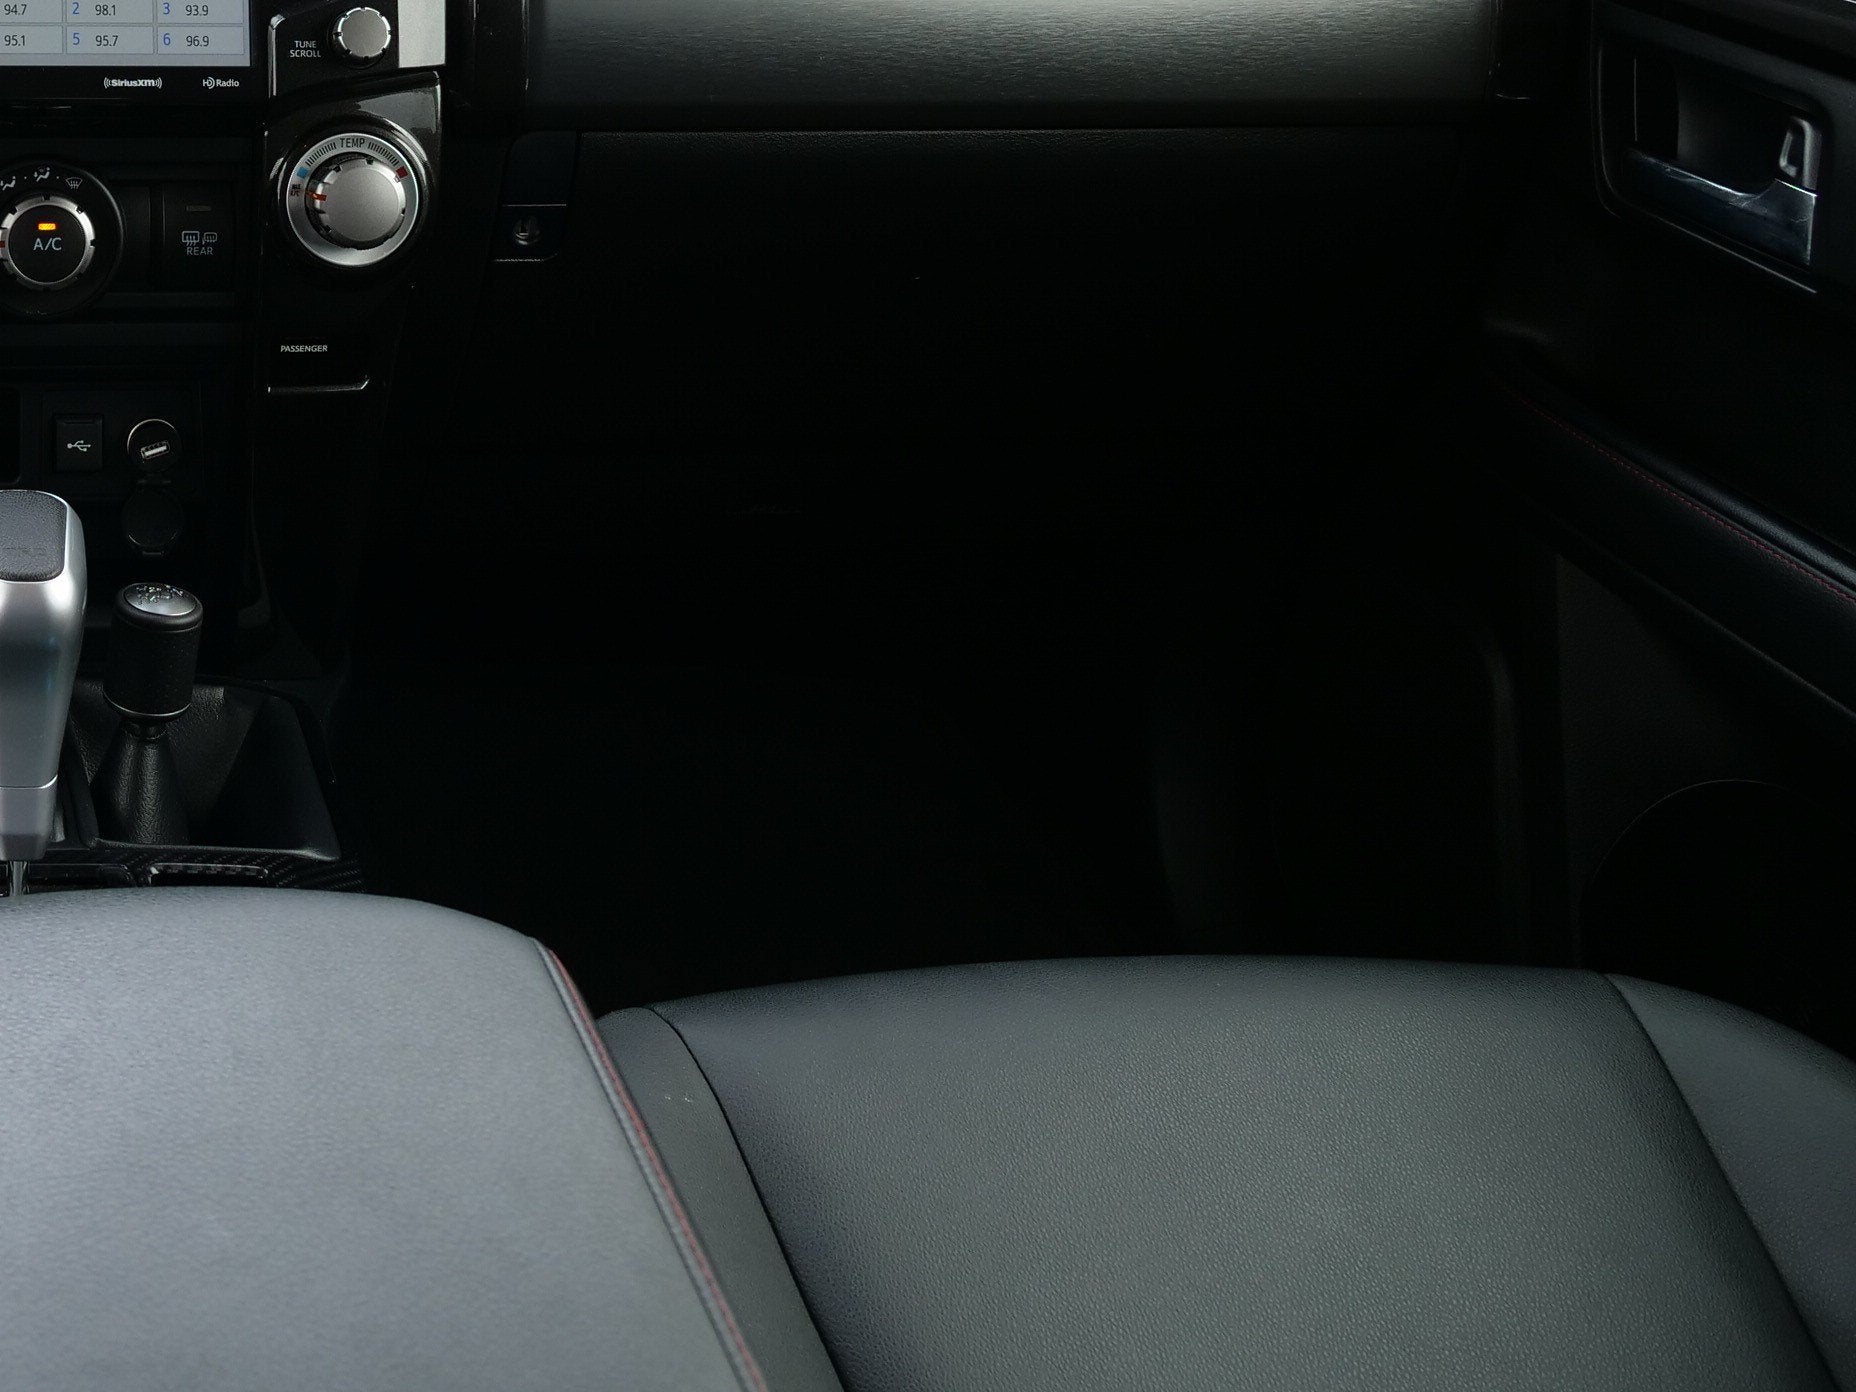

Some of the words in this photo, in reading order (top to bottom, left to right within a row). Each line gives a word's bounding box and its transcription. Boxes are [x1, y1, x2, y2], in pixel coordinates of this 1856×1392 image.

[3, 3, 28, 16] 94.7
[72, 1, 80, 15] 2
[95, 4, 116, 16] 98.1
[162, 2, 171, 15] 3
[185, 4, 209, 16] 93.9
[3, 34, 26, 47] 95.1
[72, 32, 80, 45] 5
[95, 35, 119, 47] 95.7
[162, 33, 171, 46] 6
[186, 35, 210, 47] 96.9
[294, 40, 317, 49] TUNE
[289, 49, 321, 58] SCROLL
[216, 78, 240, 87] Radio
[339, 138, 366, 149] TEMP
[33, 237, 62, 251] A/C
[186, 247, 214, 256] REAR
[280, 344, 328, 353] PASSENGER
